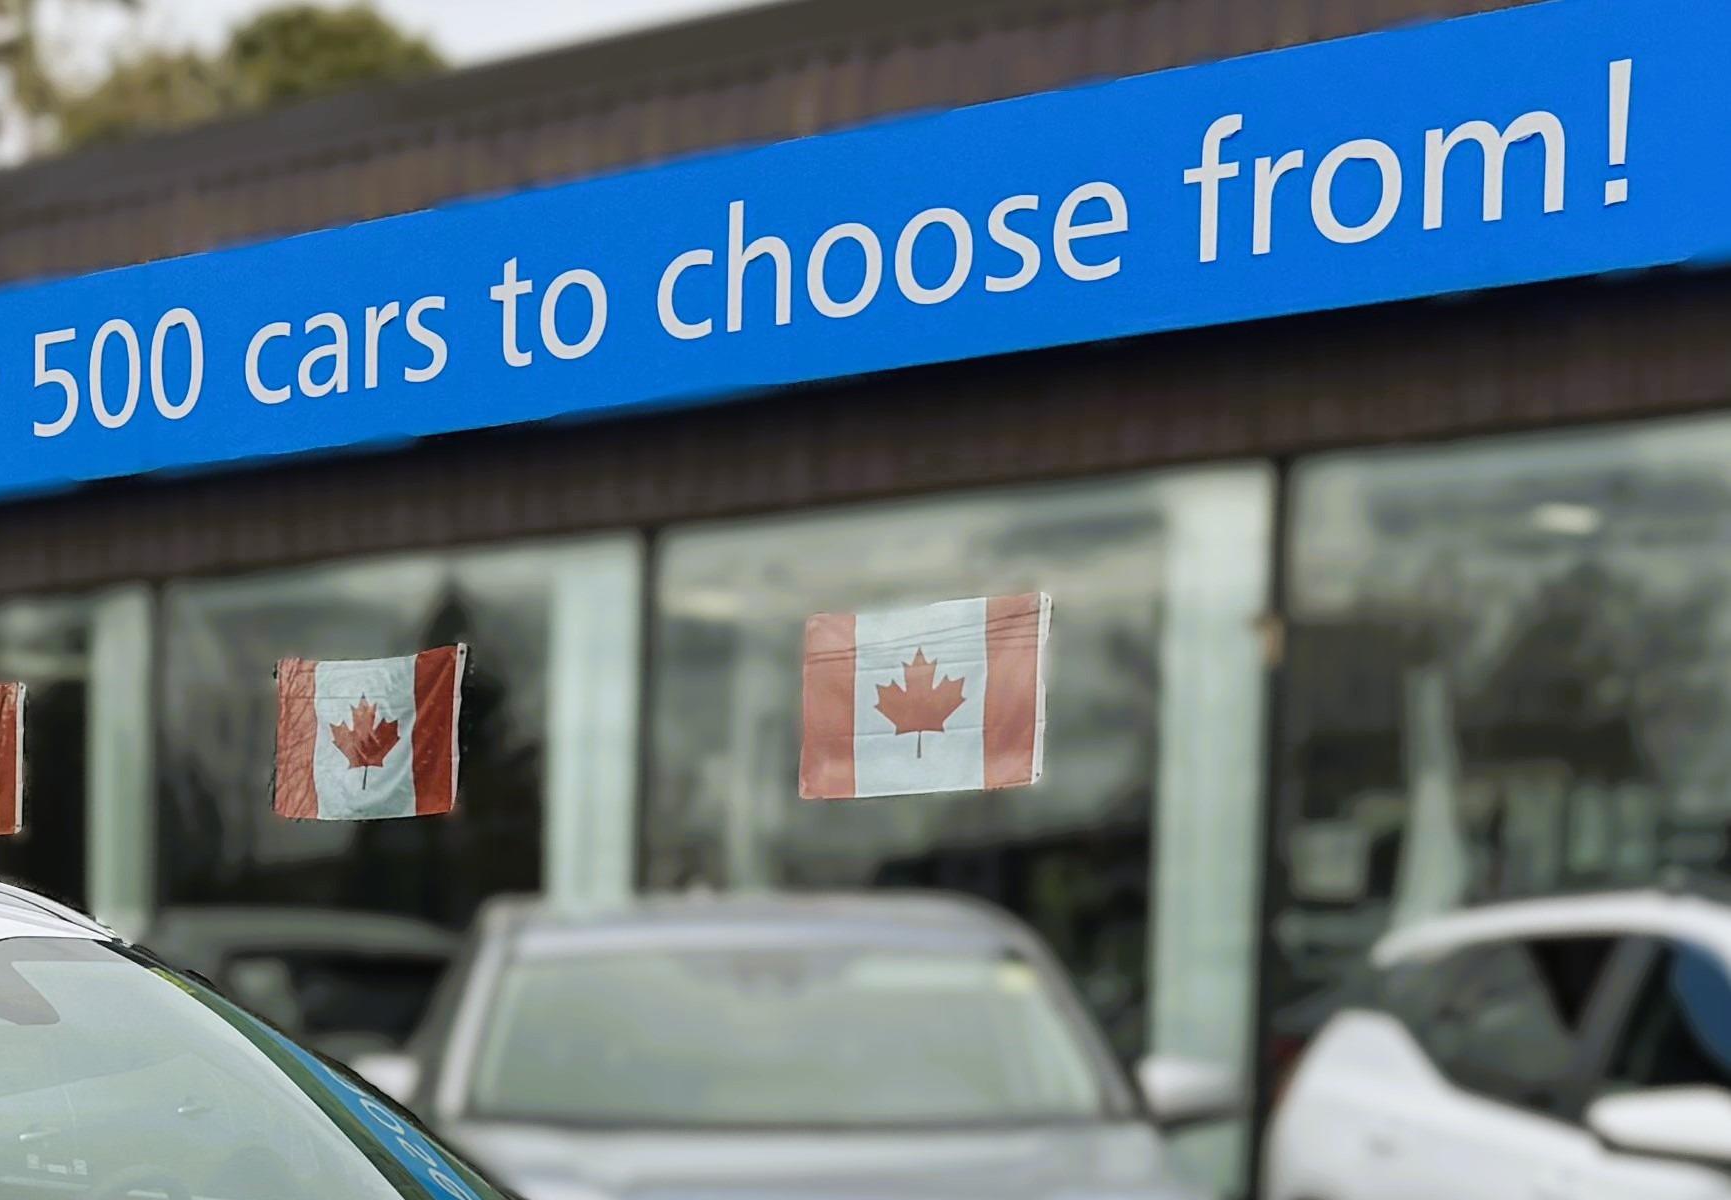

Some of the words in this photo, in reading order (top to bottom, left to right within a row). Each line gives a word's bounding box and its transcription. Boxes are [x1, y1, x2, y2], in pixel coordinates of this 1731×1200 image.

[33, 308, 204, 438] 500
[245, 295, 448, 405] cars
[490, 257, 608, 367] to
[657, 182, 1128, 340] choose
[1183, 59, 1632, 262] from!
